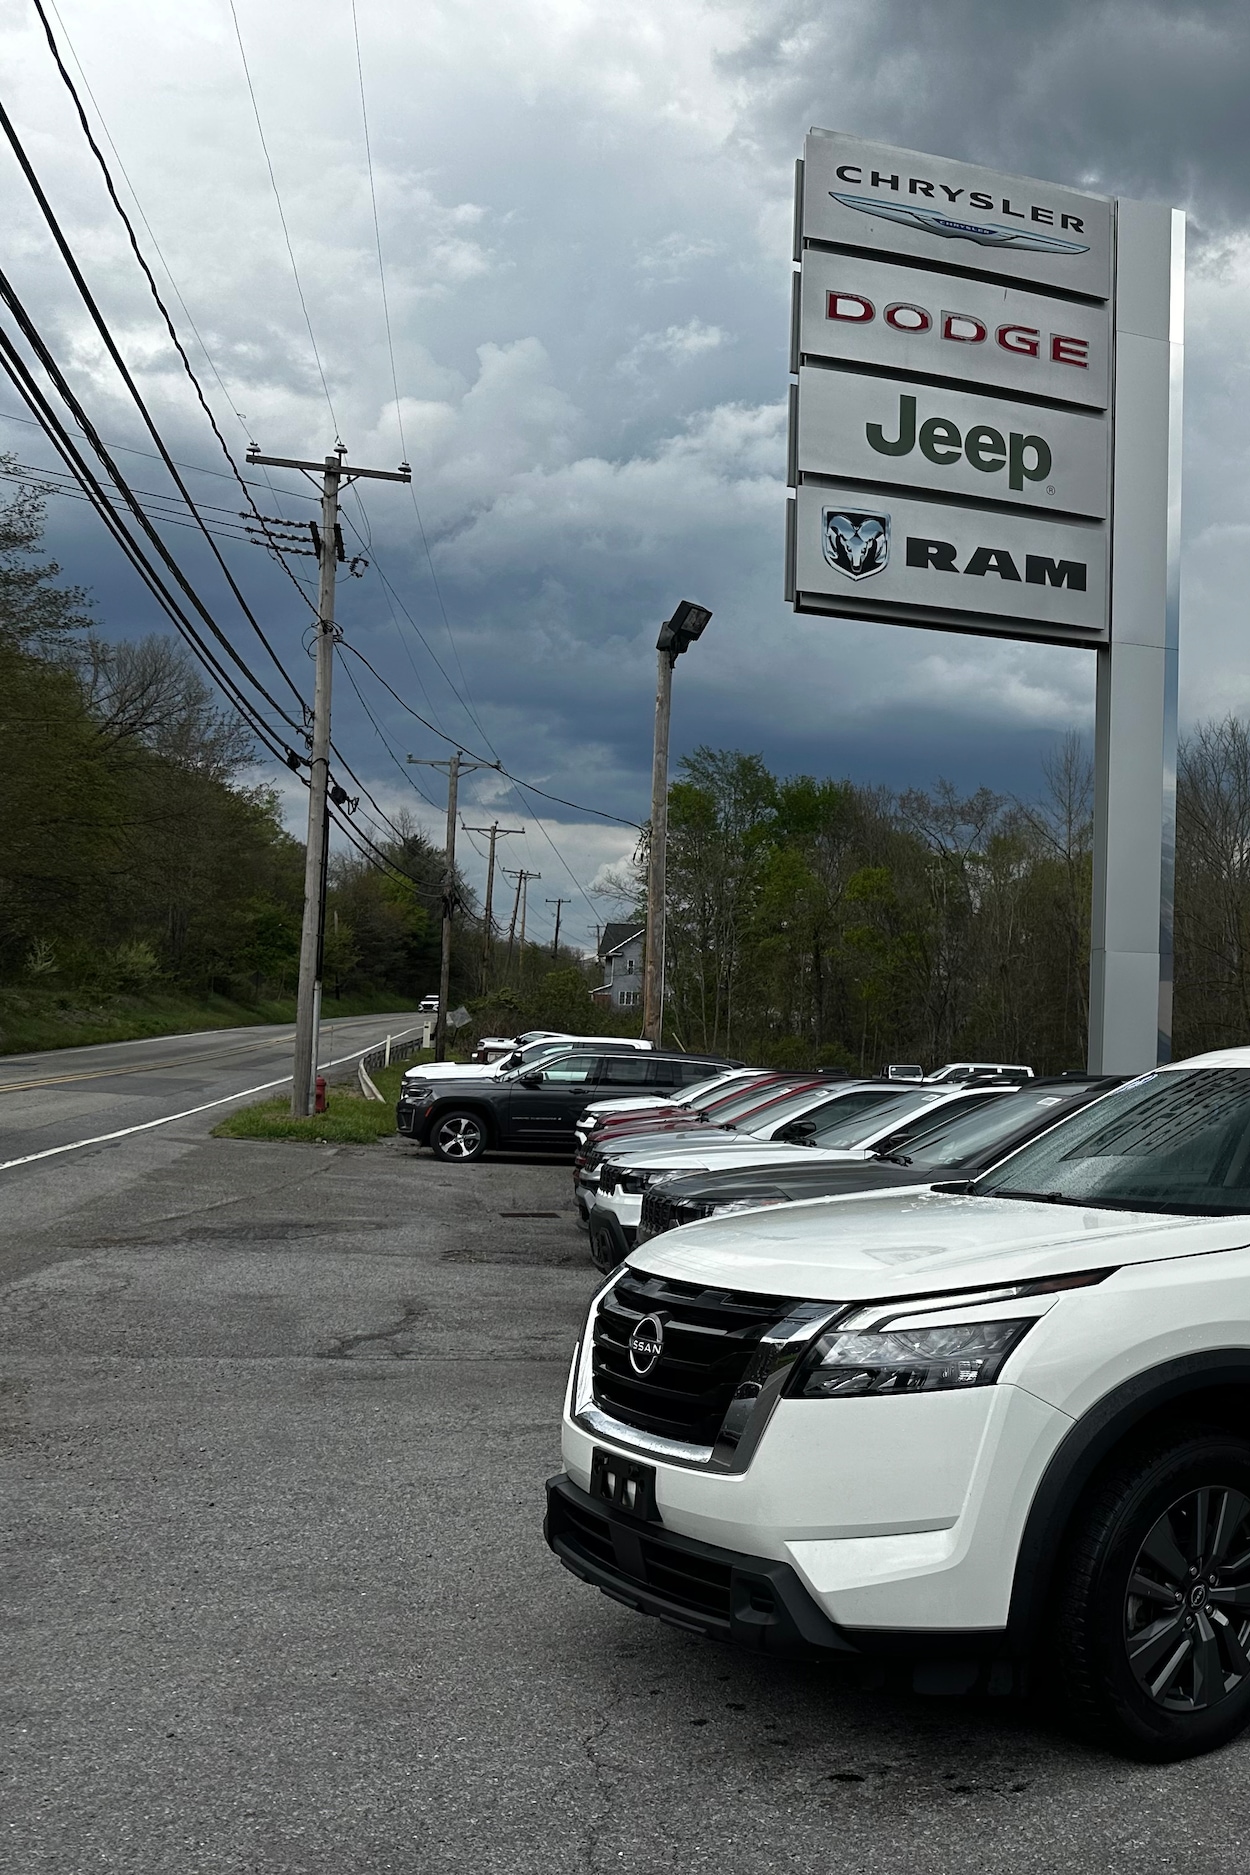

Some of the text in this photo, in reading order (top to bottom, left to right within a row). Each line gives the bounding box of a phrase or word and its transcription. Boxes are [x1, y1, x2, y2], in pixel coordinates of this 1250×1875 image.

[836, 165, 1085, 234] CHRYSLER
[825, 290, 1089, 370] DODGE
[865, 394, 1052, 491] Jeep
[905, 536, 1087, 592] RAM
[631, 1339, 662, 1355] SSAN
